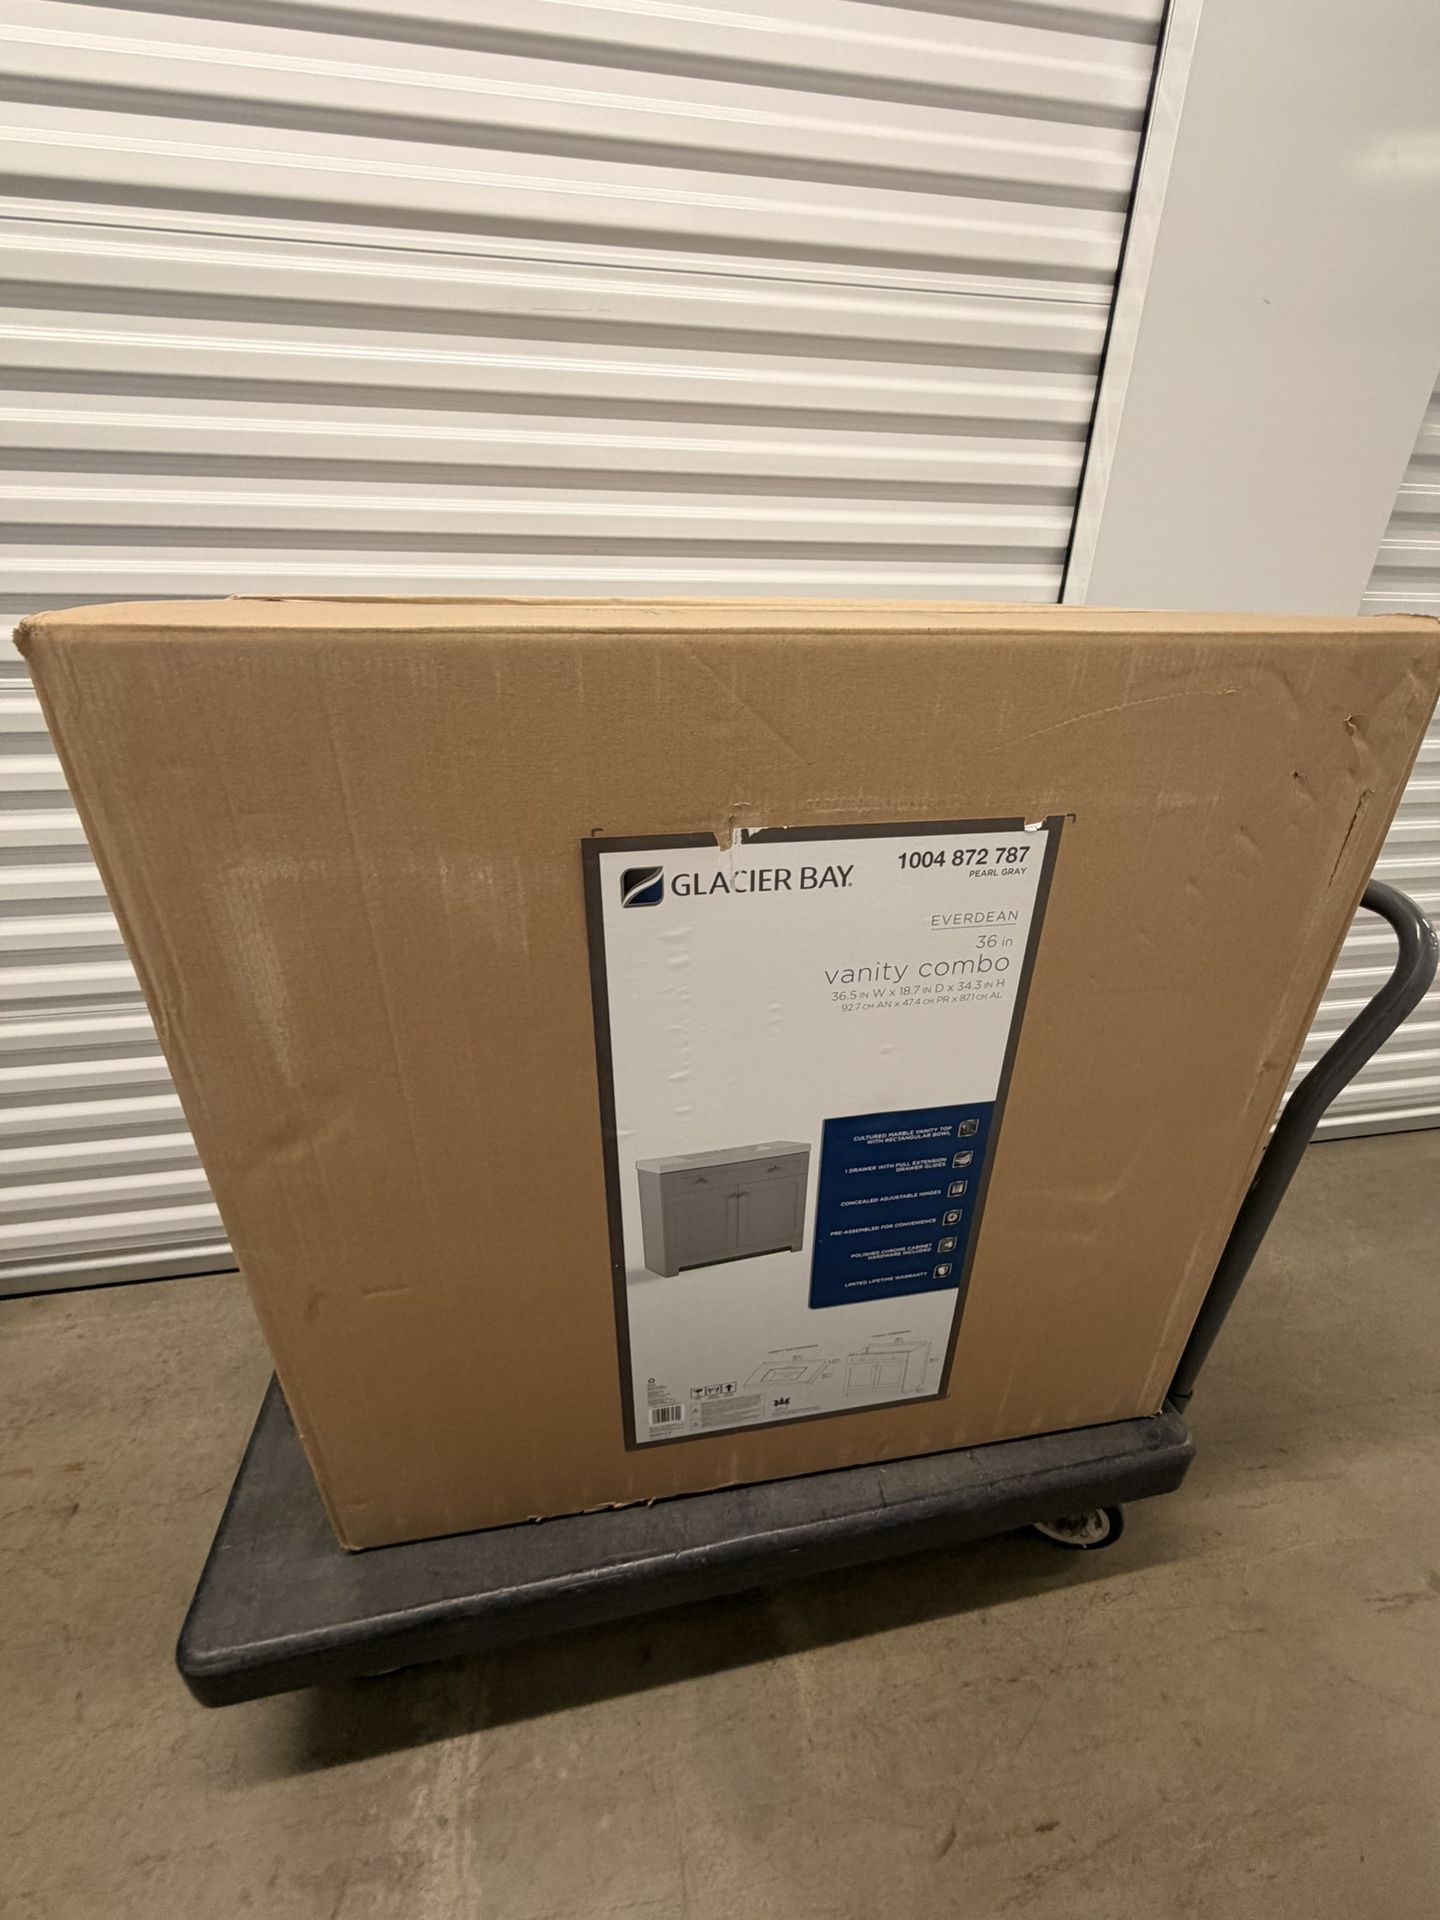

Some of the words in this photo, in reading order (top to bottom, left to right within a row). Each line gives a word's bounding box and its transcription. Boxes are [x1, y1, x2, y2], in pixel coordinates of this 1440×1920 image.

[898, 850, 946, 869] 1004
[951, 848, 989, 866] 872
[995, 846, 1031, 864] 787
[969, 869, 998, 878] PEARL
[1001, 867, 1028, 876] GRAY
[671, 868, 792, 897] GLACIER
[931, 910, 1019, 926] EVERDEAN
[976, 934, 998, 948] 36
[1002, 936, 1014, 947] in
[824, 961, 909, 985] vanity
[918, 953, 1010, 978] combo
[831, 990, 857, 1001] 36.5
[872, 988, 886, 998] W
[900, 985, 920, 996] 18.7
[935, 983, 944, 993] D
[957, 980, 982, 991] 34.3
[996, 978, 1006, 988] H
[876, 1000, 892, 1010] AN
[936, 995, 950, 1004] PR
[989, 991, 1002, 1000] AL
[853, 1133, 887, 1142] CULTURED
[884, 1133, 931, 1143] RECTANGULAR
[848, 1165, 877, 1174] DRAWER
[912, 1157, 947, 1166] EXTENSION
[896, 1164, 924, 1172] DRAWER
[840, 1198, 879, 1207] CONCEALED
[880, 1192, 918, 1202] ADJUSTABLE
[830, 1226, 880, 1236] PRE-ASSEMBLED
[894, 1218, 937, 1228] CONVENIENCE
[868, 1276, 894, 1284] LIFETIME
[894, 1272, 928, 1280] WARRANTY
